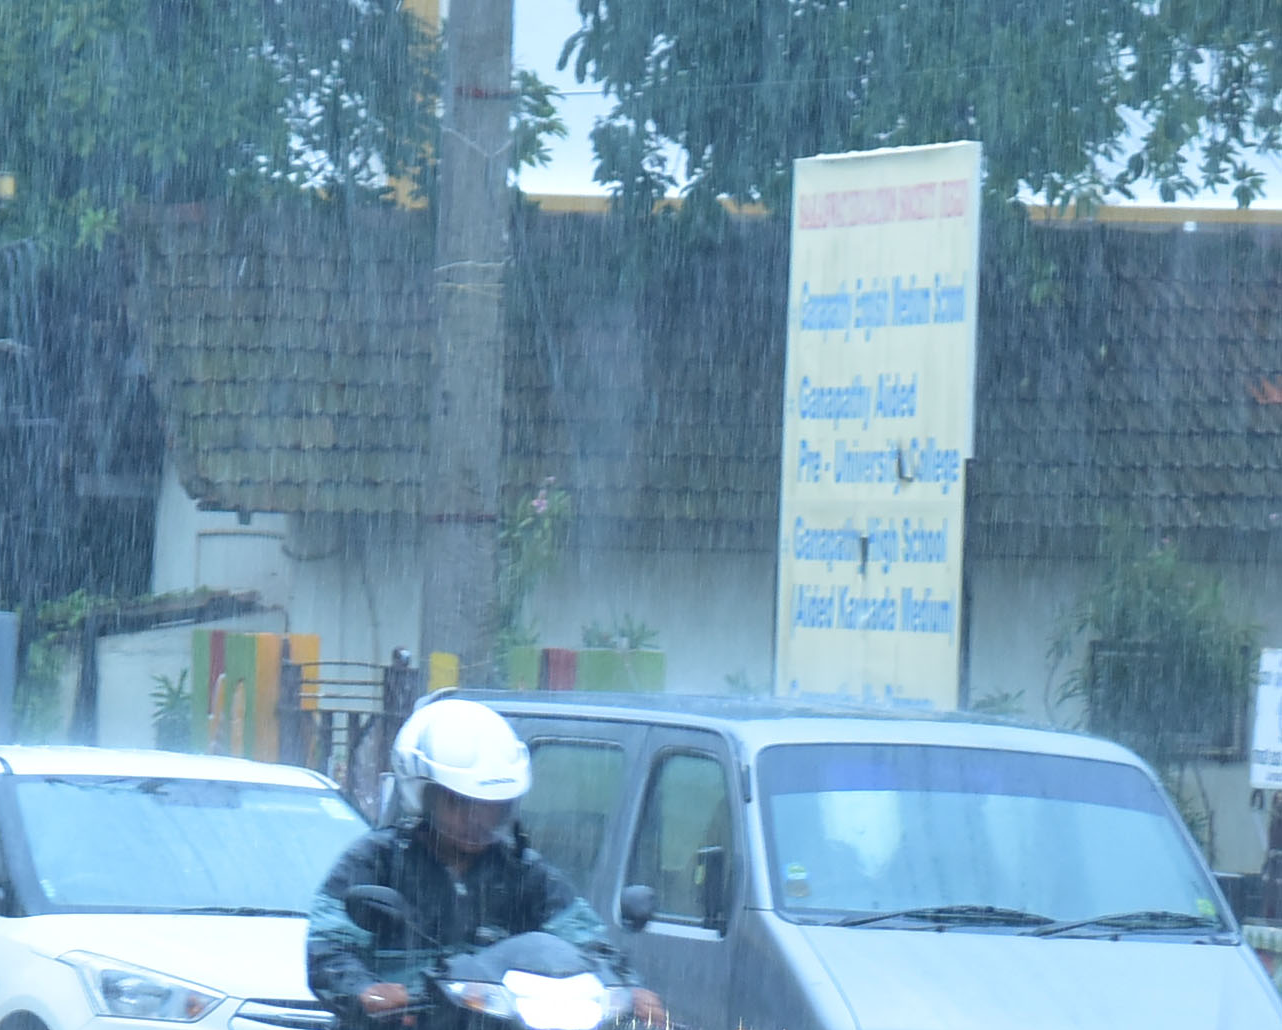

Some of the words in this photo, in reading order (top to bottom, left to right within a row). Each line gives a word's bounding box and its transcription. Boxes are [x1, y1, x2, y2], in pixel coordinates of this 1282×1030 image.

[799, 375, 871, 431] Ganapathy
[876, 373, 917, 419] Aided
[798, 438, 821, 484] Pre
[903, 517, 949, 563] School
